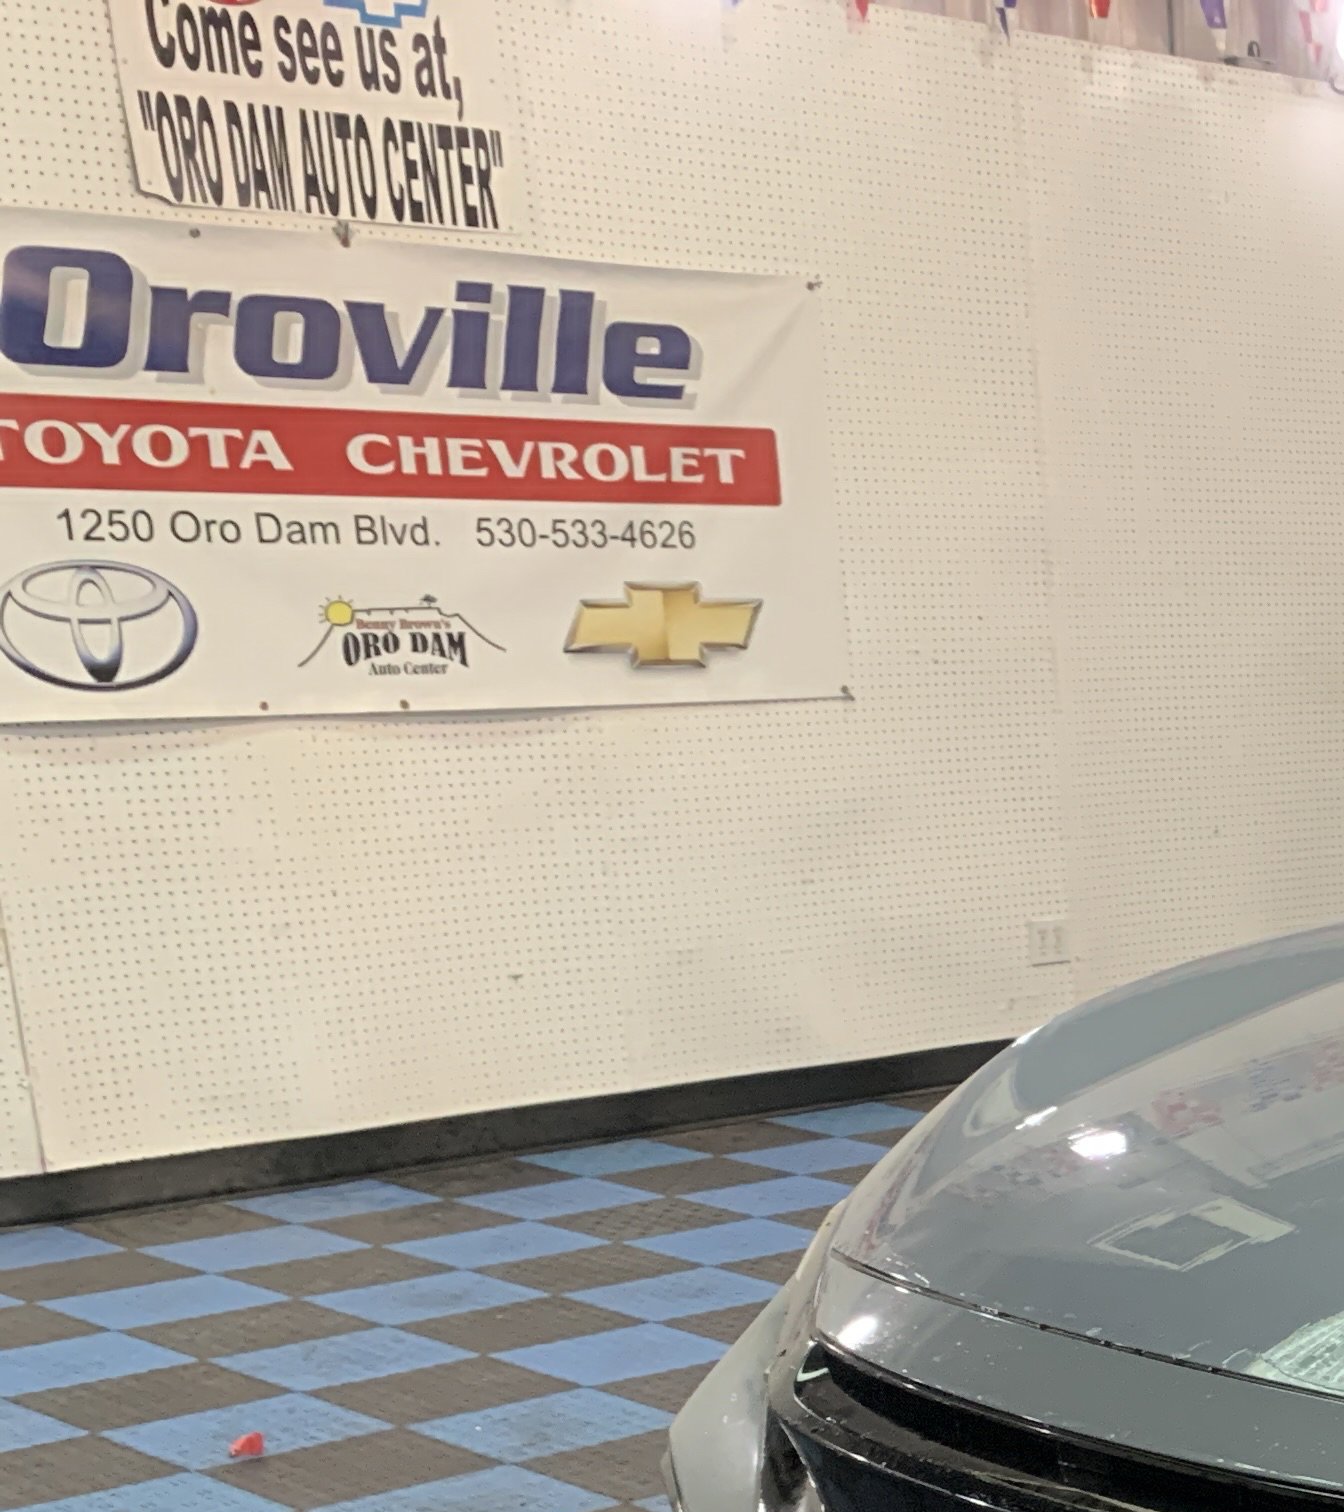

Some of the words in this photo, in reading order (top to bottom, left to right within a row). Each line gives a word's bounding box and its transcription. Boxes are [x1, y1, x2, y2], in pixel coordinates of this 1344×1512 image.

[145, 0, 263, 78] Come
[273, 15, 345, 87] see
[354, 26, 401, 93] us
[412, 15, 463, 121] at,
[137, 89, 223, 205] "ORO
[223, 100, 296, 211] DAM
[300, 107, 377, 219] AUTO
[383, 117, 503, 229] CENTER"
[0, 245, 692, 400] Oroville
[346, 433, 746, 484] CHEVROLET
[57, 508, 154, 543] 1250
[170, 510, 241, 544] Oro
[254, 512, 341, 545] Dam
[354, 515, 440, 547] Blvd.
[476, 517, 696, 549] 530-533-4626
[342, 631, 400, 666] ORO
[409, 631, 469, 668] DAM
[368, 662, 400, 676] Auto
[403, 662, 448, 675] Center
